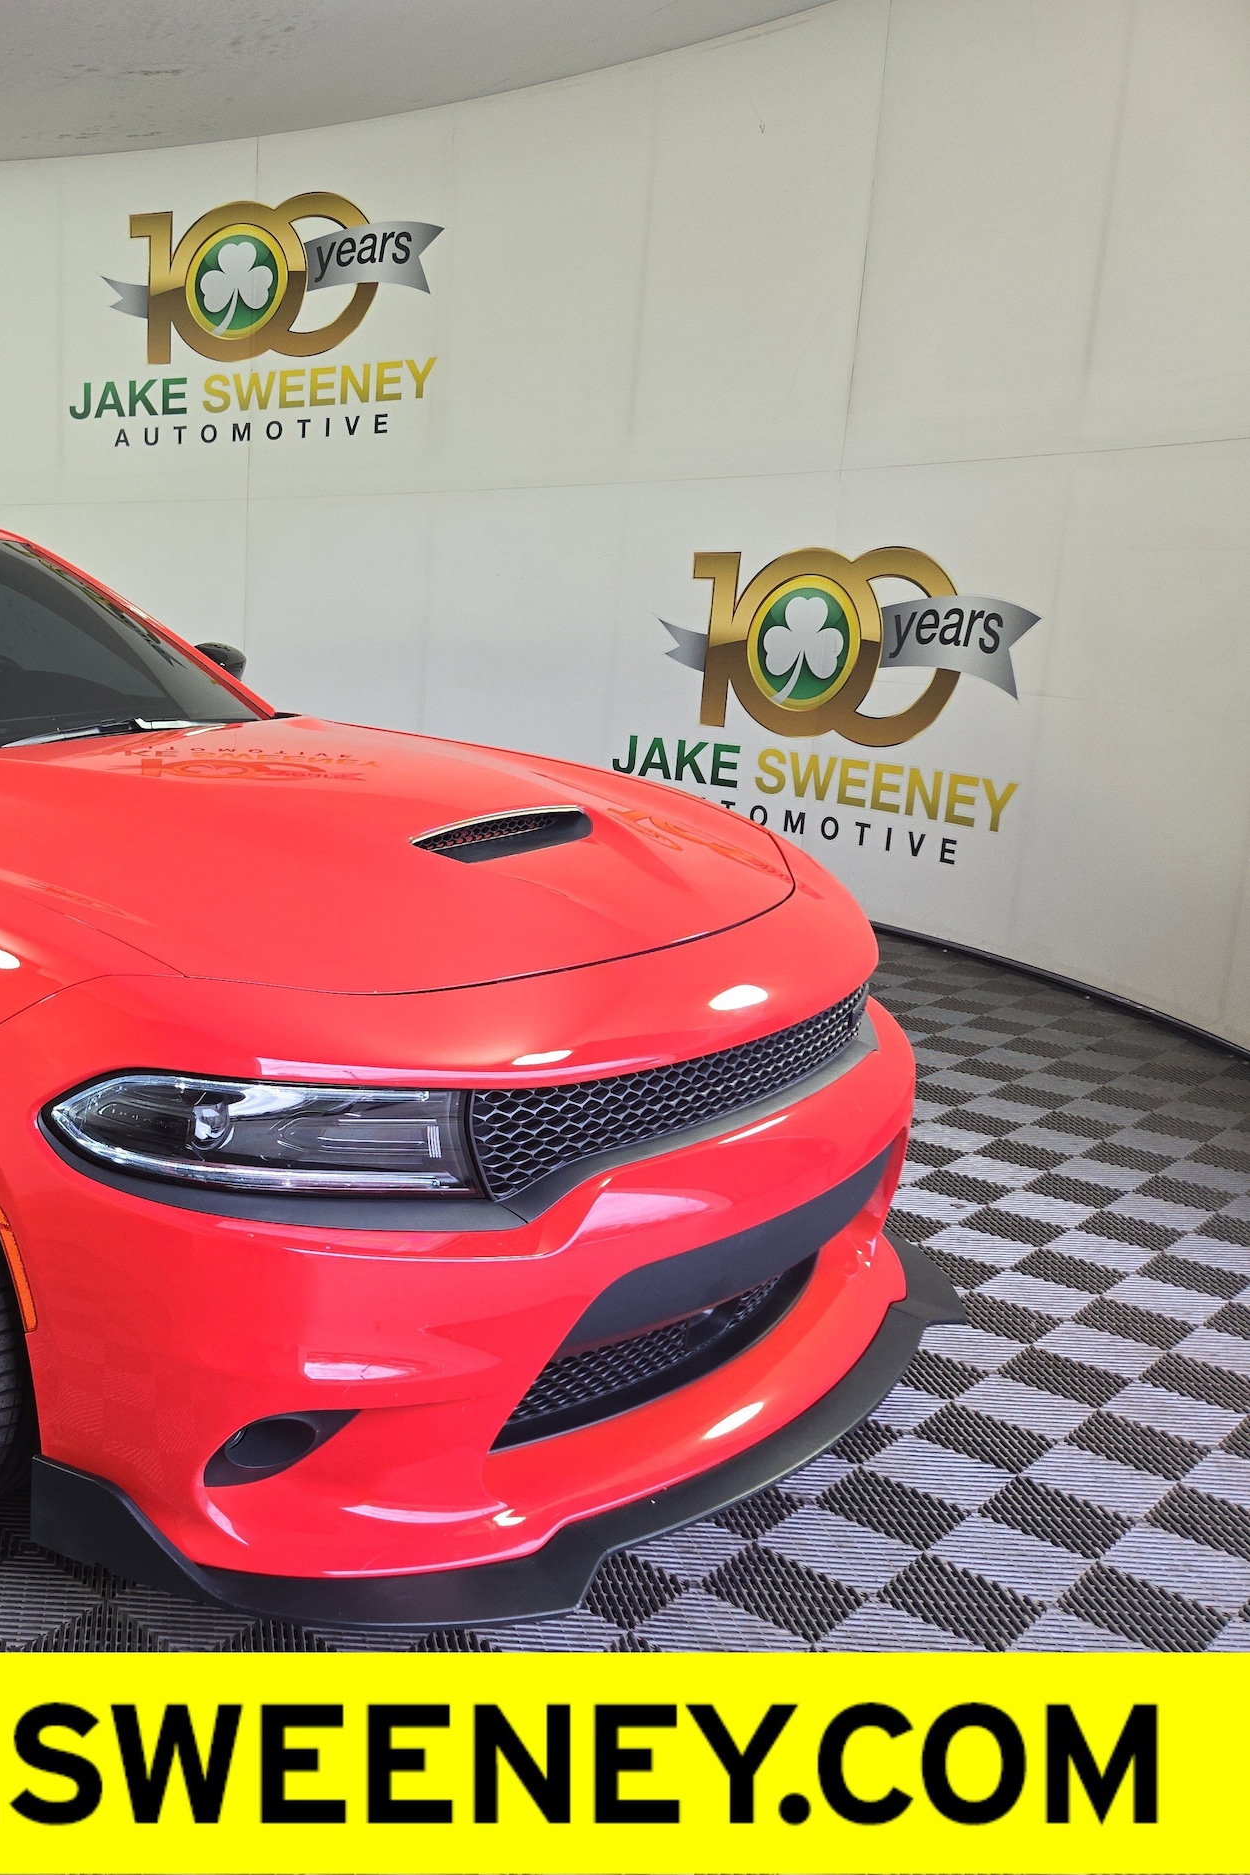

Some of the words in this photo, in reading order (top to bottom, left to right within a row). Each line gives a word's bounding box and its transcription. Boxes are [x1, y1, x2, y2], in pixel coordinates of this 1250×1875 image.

[314, 226, 413, 281] years
[69, 377, 188, 420] JAKE
[202, 357, 438, 414] SWEENEY
[114, 413, 389, 448] AUTOMOTIVE
[888, 606, 1004, 659] years
[612, 735, 741, 789] JAKE
[754, 748, 1019, 833] SWEENEY
